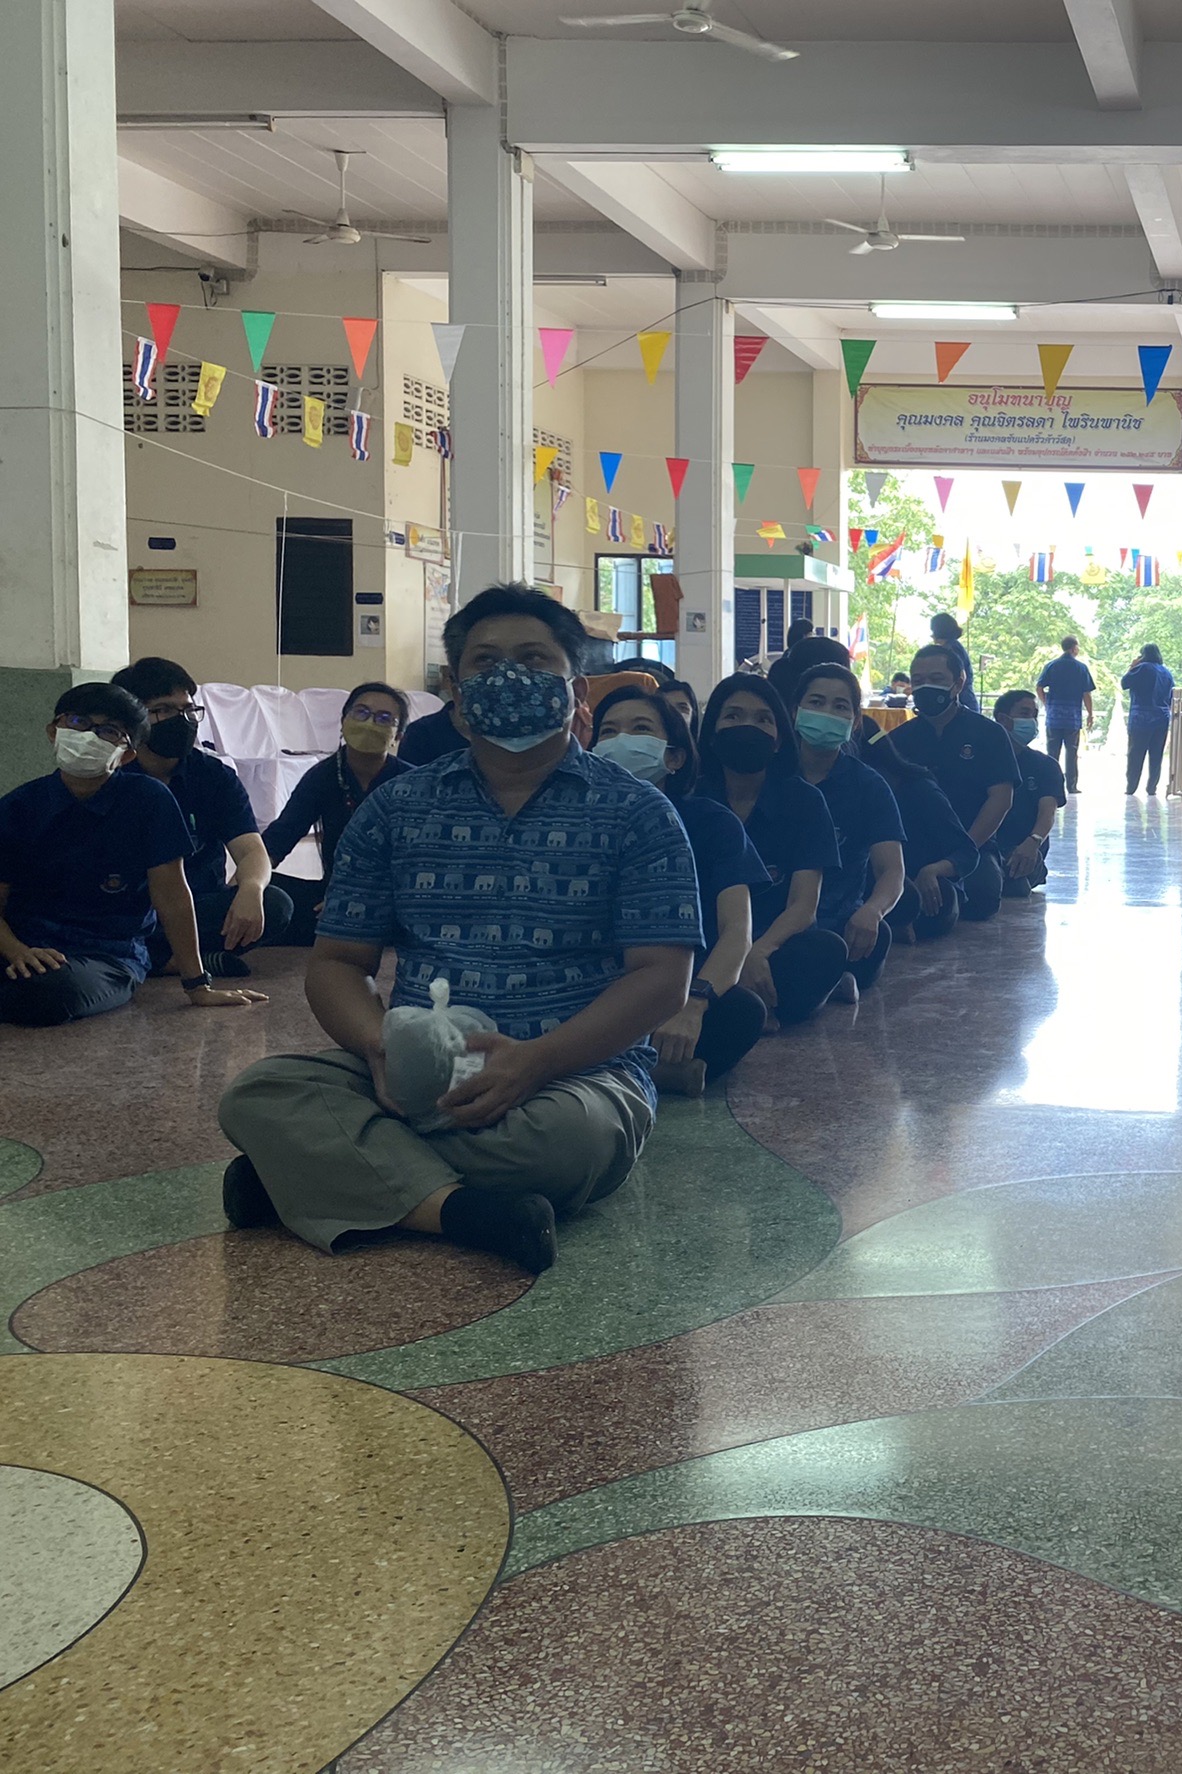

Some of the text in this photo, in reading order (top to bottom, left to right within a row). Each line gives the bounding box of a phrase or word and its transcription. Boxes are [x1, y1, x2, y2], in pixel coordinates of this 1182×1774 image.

[968, 386, 1073, 412] อนุโมทนาบุญ
[897, 410, 1145, 431] คุณมงคล คุณจิตรลดา ไพรินพานิช
